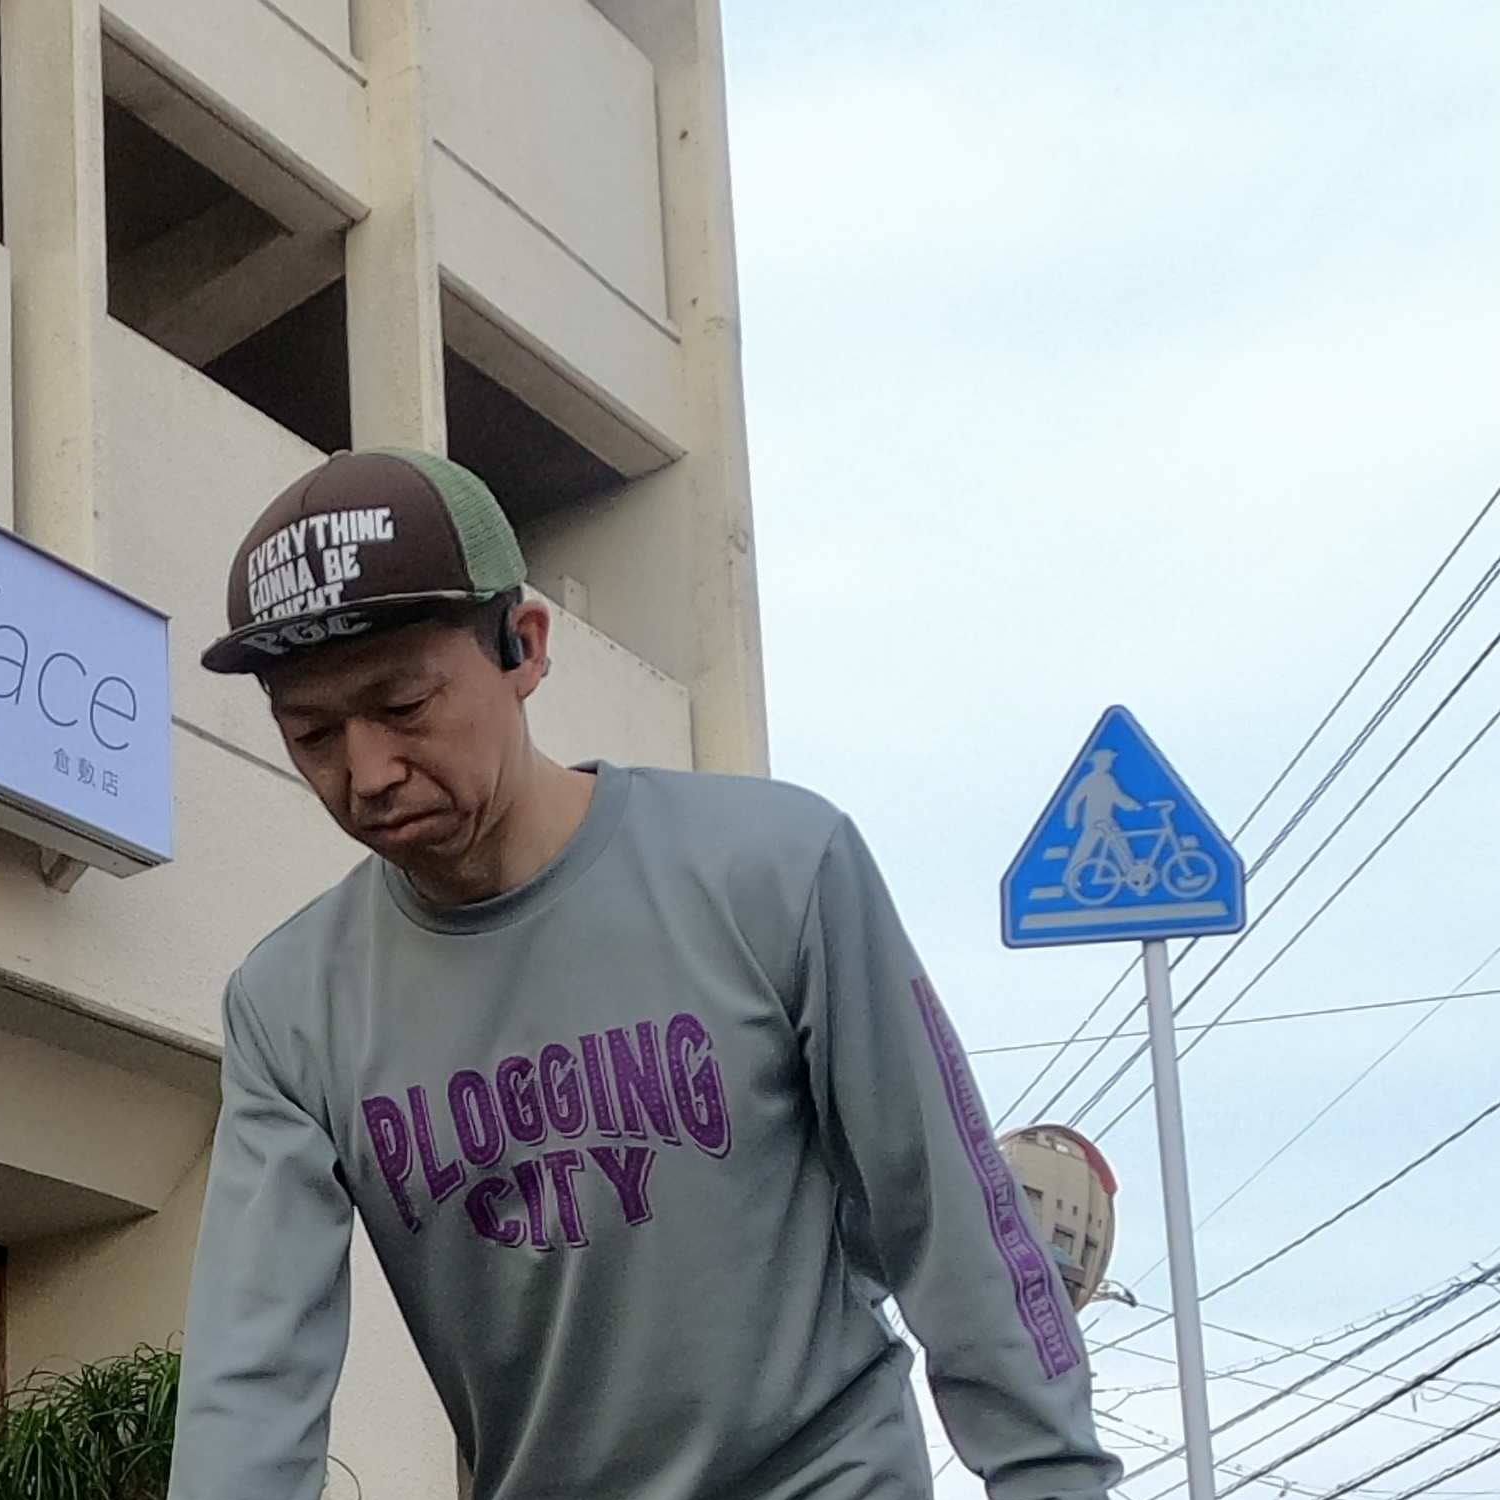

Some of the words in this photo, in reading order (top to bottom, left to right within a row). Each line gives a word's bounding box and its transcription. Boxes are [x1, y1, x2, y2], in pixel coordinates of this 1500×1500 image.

[248, 507, 395, 585] EVERYTHING
[249, 555, 317, 618] GONNA
[322, 543, 362, 584] BE
[53, 747, 119, 797] 倉敷店
[361, 1012, 731, 1235] PLOGGING
[463, 1145, 657, 1252] CITY
